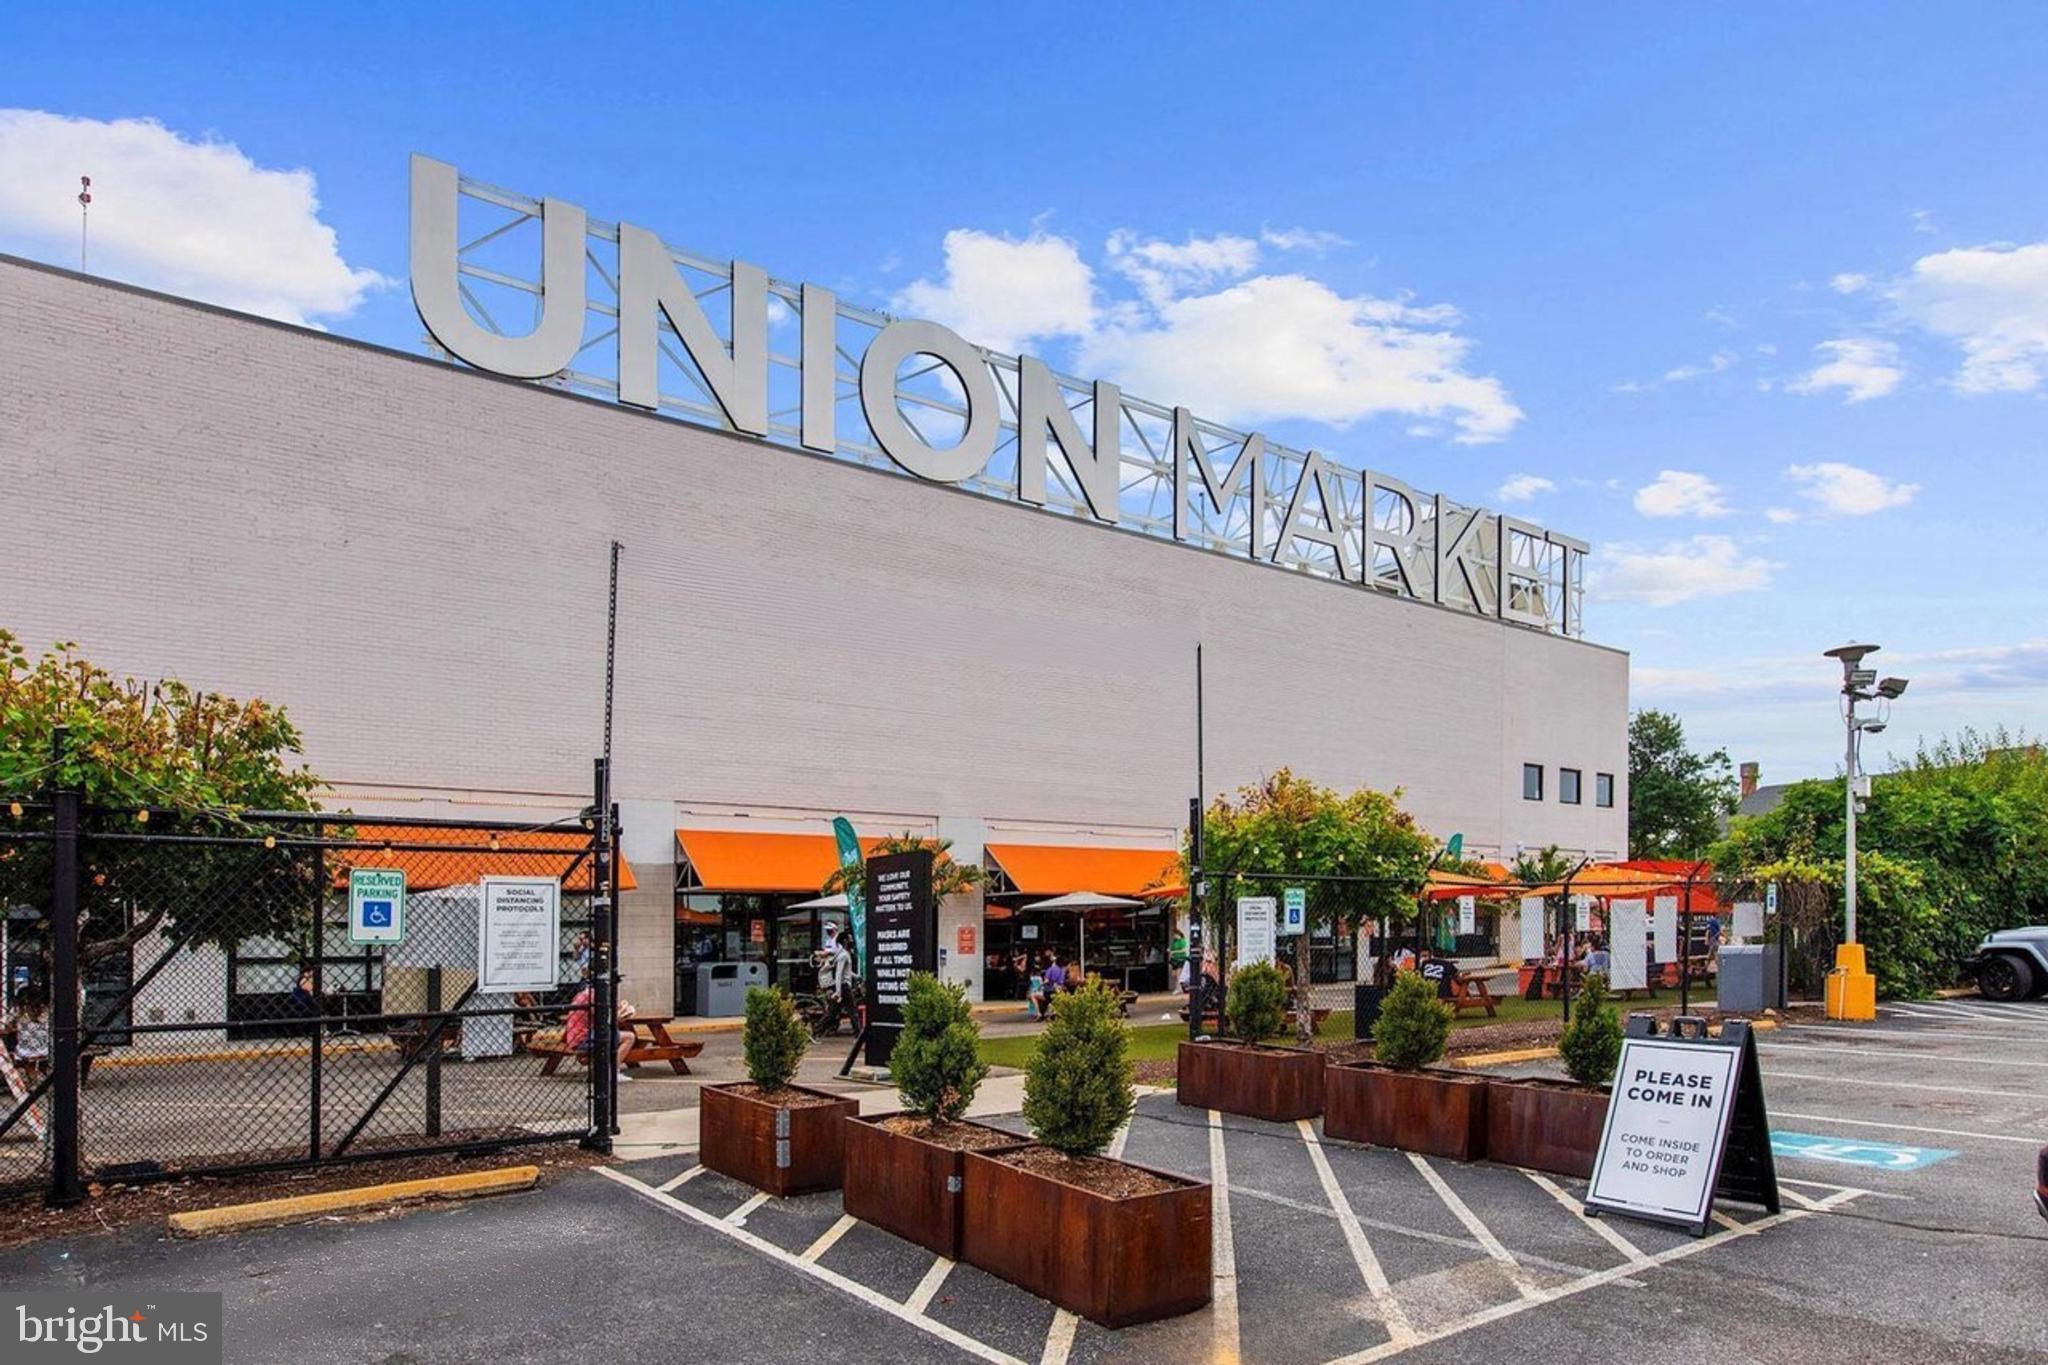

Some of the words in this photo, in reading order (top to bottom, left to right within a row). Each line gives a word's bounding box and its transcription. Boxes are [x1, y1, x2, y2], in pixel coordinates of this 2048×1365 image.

[410, 153, 1120, 523] UNION
[1174, 406, 1590, 635] MARKET
[354, 875, 401, 887] RESERVED
[357, 887, 398, 899] PARKING
[506, 888, 535, 896] SOCIAL
[496, 897, 544, 905] DISTANCING
[496, 905, 545, 913] PROTOCOLS
[1424, 963, 1444, 979] 22
[1635, 1069, 1713, 1089] PLEASE
[1627, 1087, 1684, 1106] COME
[1691, 1094, 1713, 1109] IN
[1620, 1133, 1656, 1146] COME
[1659, 1138, 1700, 1152] INSIDE
[1626, 1146, 1642, 1158] TO
[1645, 1150, 1689, 1165] ORDER
[1621, 1160, 1648, 1172] AND
[1652, 1164, 1687, 1178] SHOP
